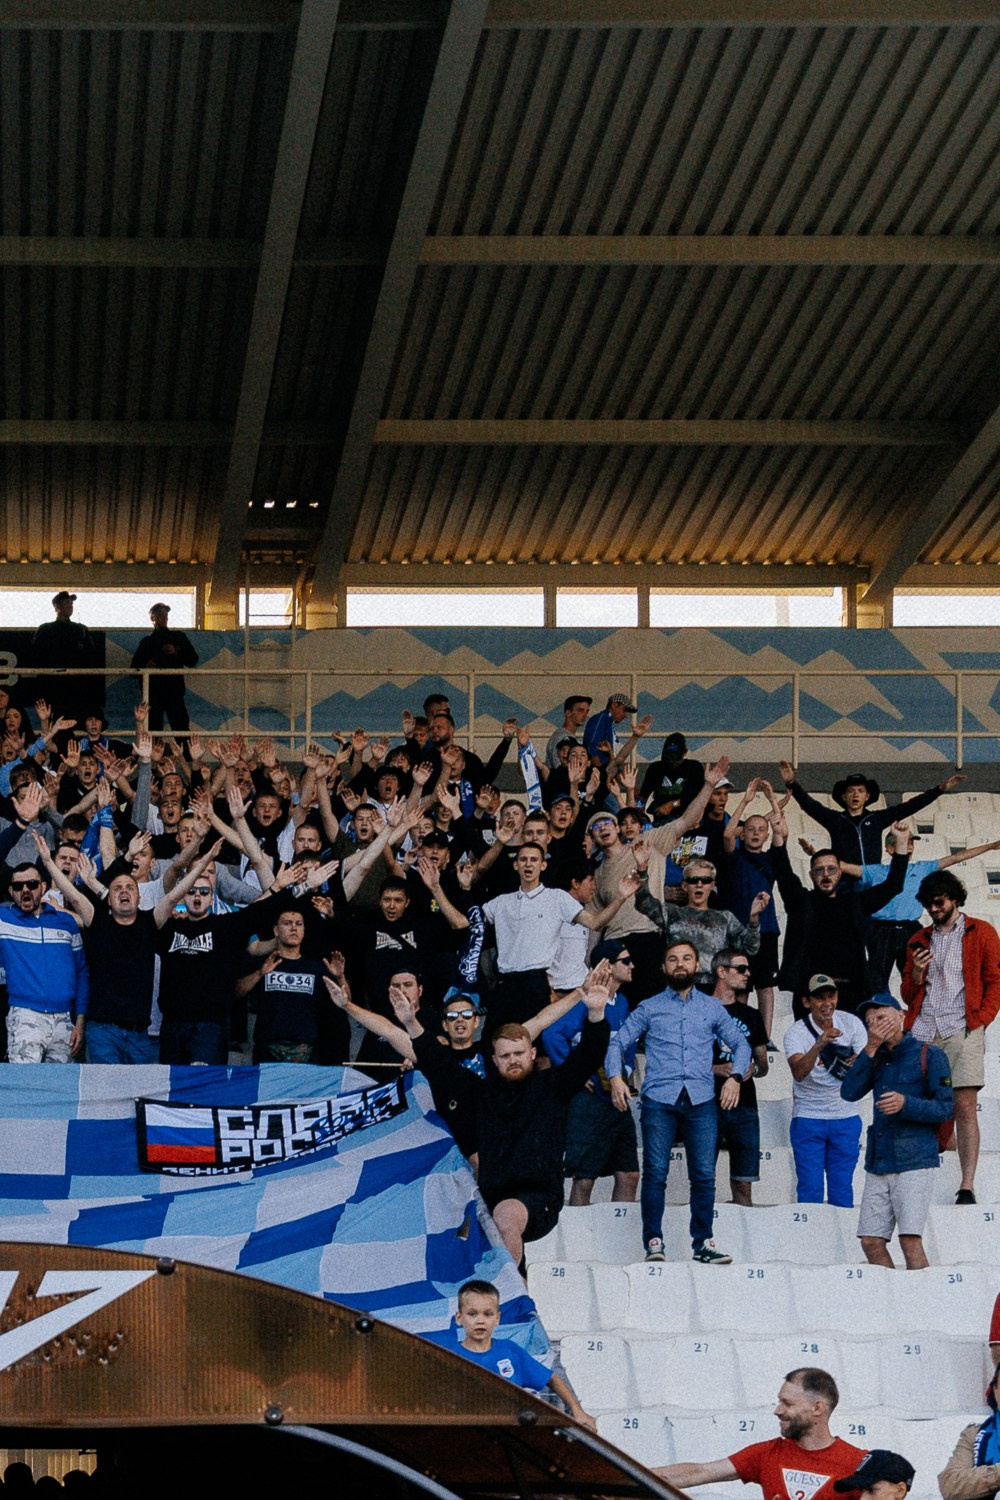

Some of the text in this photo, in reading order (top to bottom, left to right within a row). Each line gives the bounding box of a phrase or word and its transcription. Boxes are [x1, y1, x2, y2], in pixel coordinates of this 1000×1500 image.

[270, 973, 311, 987] FC 34
[162, 1164, 245, 1175] ЗЕНИТ
[615, 1207, 628, 1217] 27
[793, 1213, 808, 1222] 29
[552, 1267, 565, 1277] 26
[649, 1266, 662, 1276] 27
[748, 1269, 764, 1278] 28
[846, 1269, 863, 1279] 29
[948, 1274, 963, 1284] 30
[587, 1341, 603, 1351] 26
[694, 1342, 709, 1353] 27
[800, 1343, 819, 1353] 28
[904, 1345, 921, 1355] 29
[623, 1418, 639, 1430] 26
[739, 1421, 755, 1432] 27
[848, 1424, 866, 1435] 28
[784, 1469, 823, 1487] GUESS
